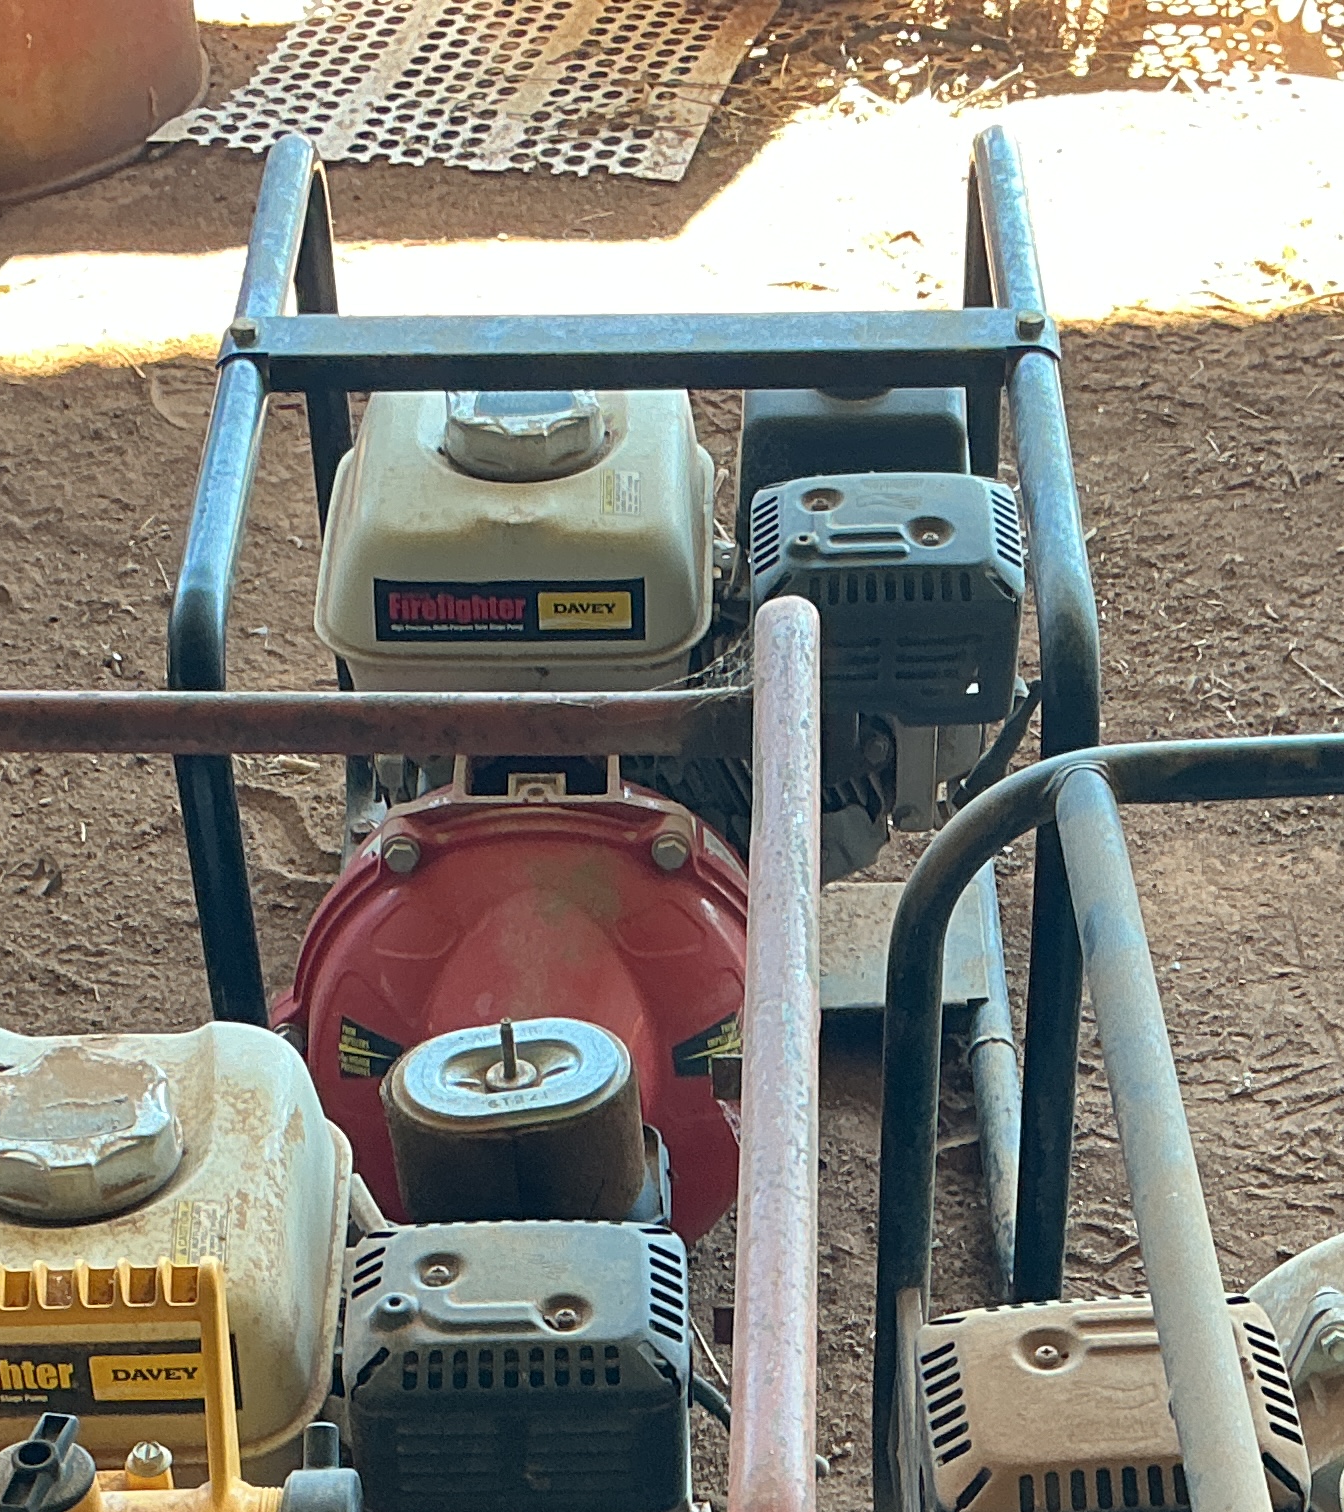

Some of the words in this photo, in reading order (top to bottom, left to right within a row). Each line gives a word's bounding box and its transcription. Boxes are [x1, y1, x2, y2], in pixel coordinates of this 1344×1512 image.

[389, 592, 526, 623] Firefighter
[553, 602, 616, 615] DAVEY
[111, 1366, 199, 1383] DAVEY
